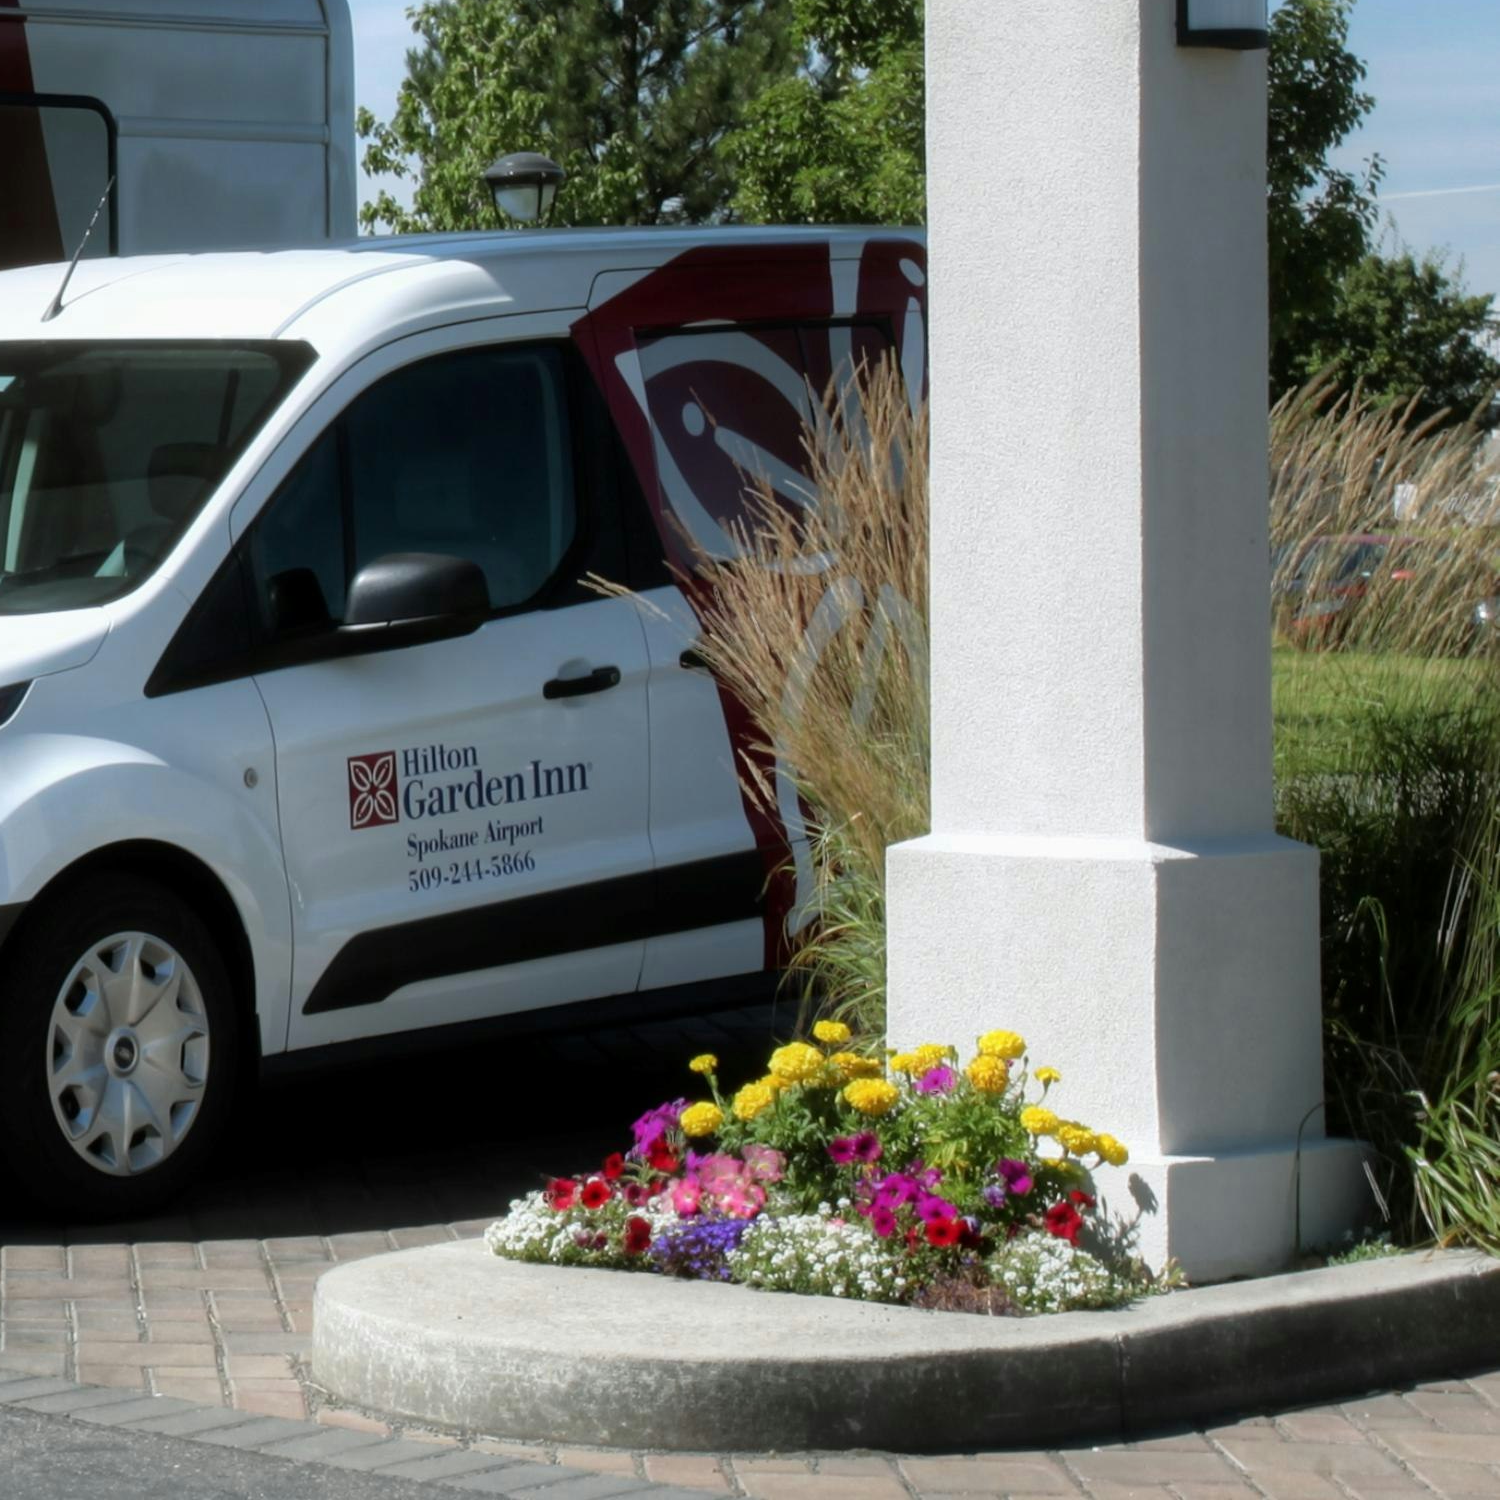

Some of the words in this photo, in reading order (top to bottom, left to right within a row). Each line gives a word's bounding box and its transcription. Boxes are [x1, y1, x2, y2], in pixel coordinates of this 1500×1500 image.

[402, 744, 479, 778] Hilton
[402, 770, 527, 821] Garden
[530, 760, 590, 799] Inn
[407, 828, 480, 862] Spokane
[484, 816, 544, 846] Airport
[408, 850, 536, 893] 509-244-5866
